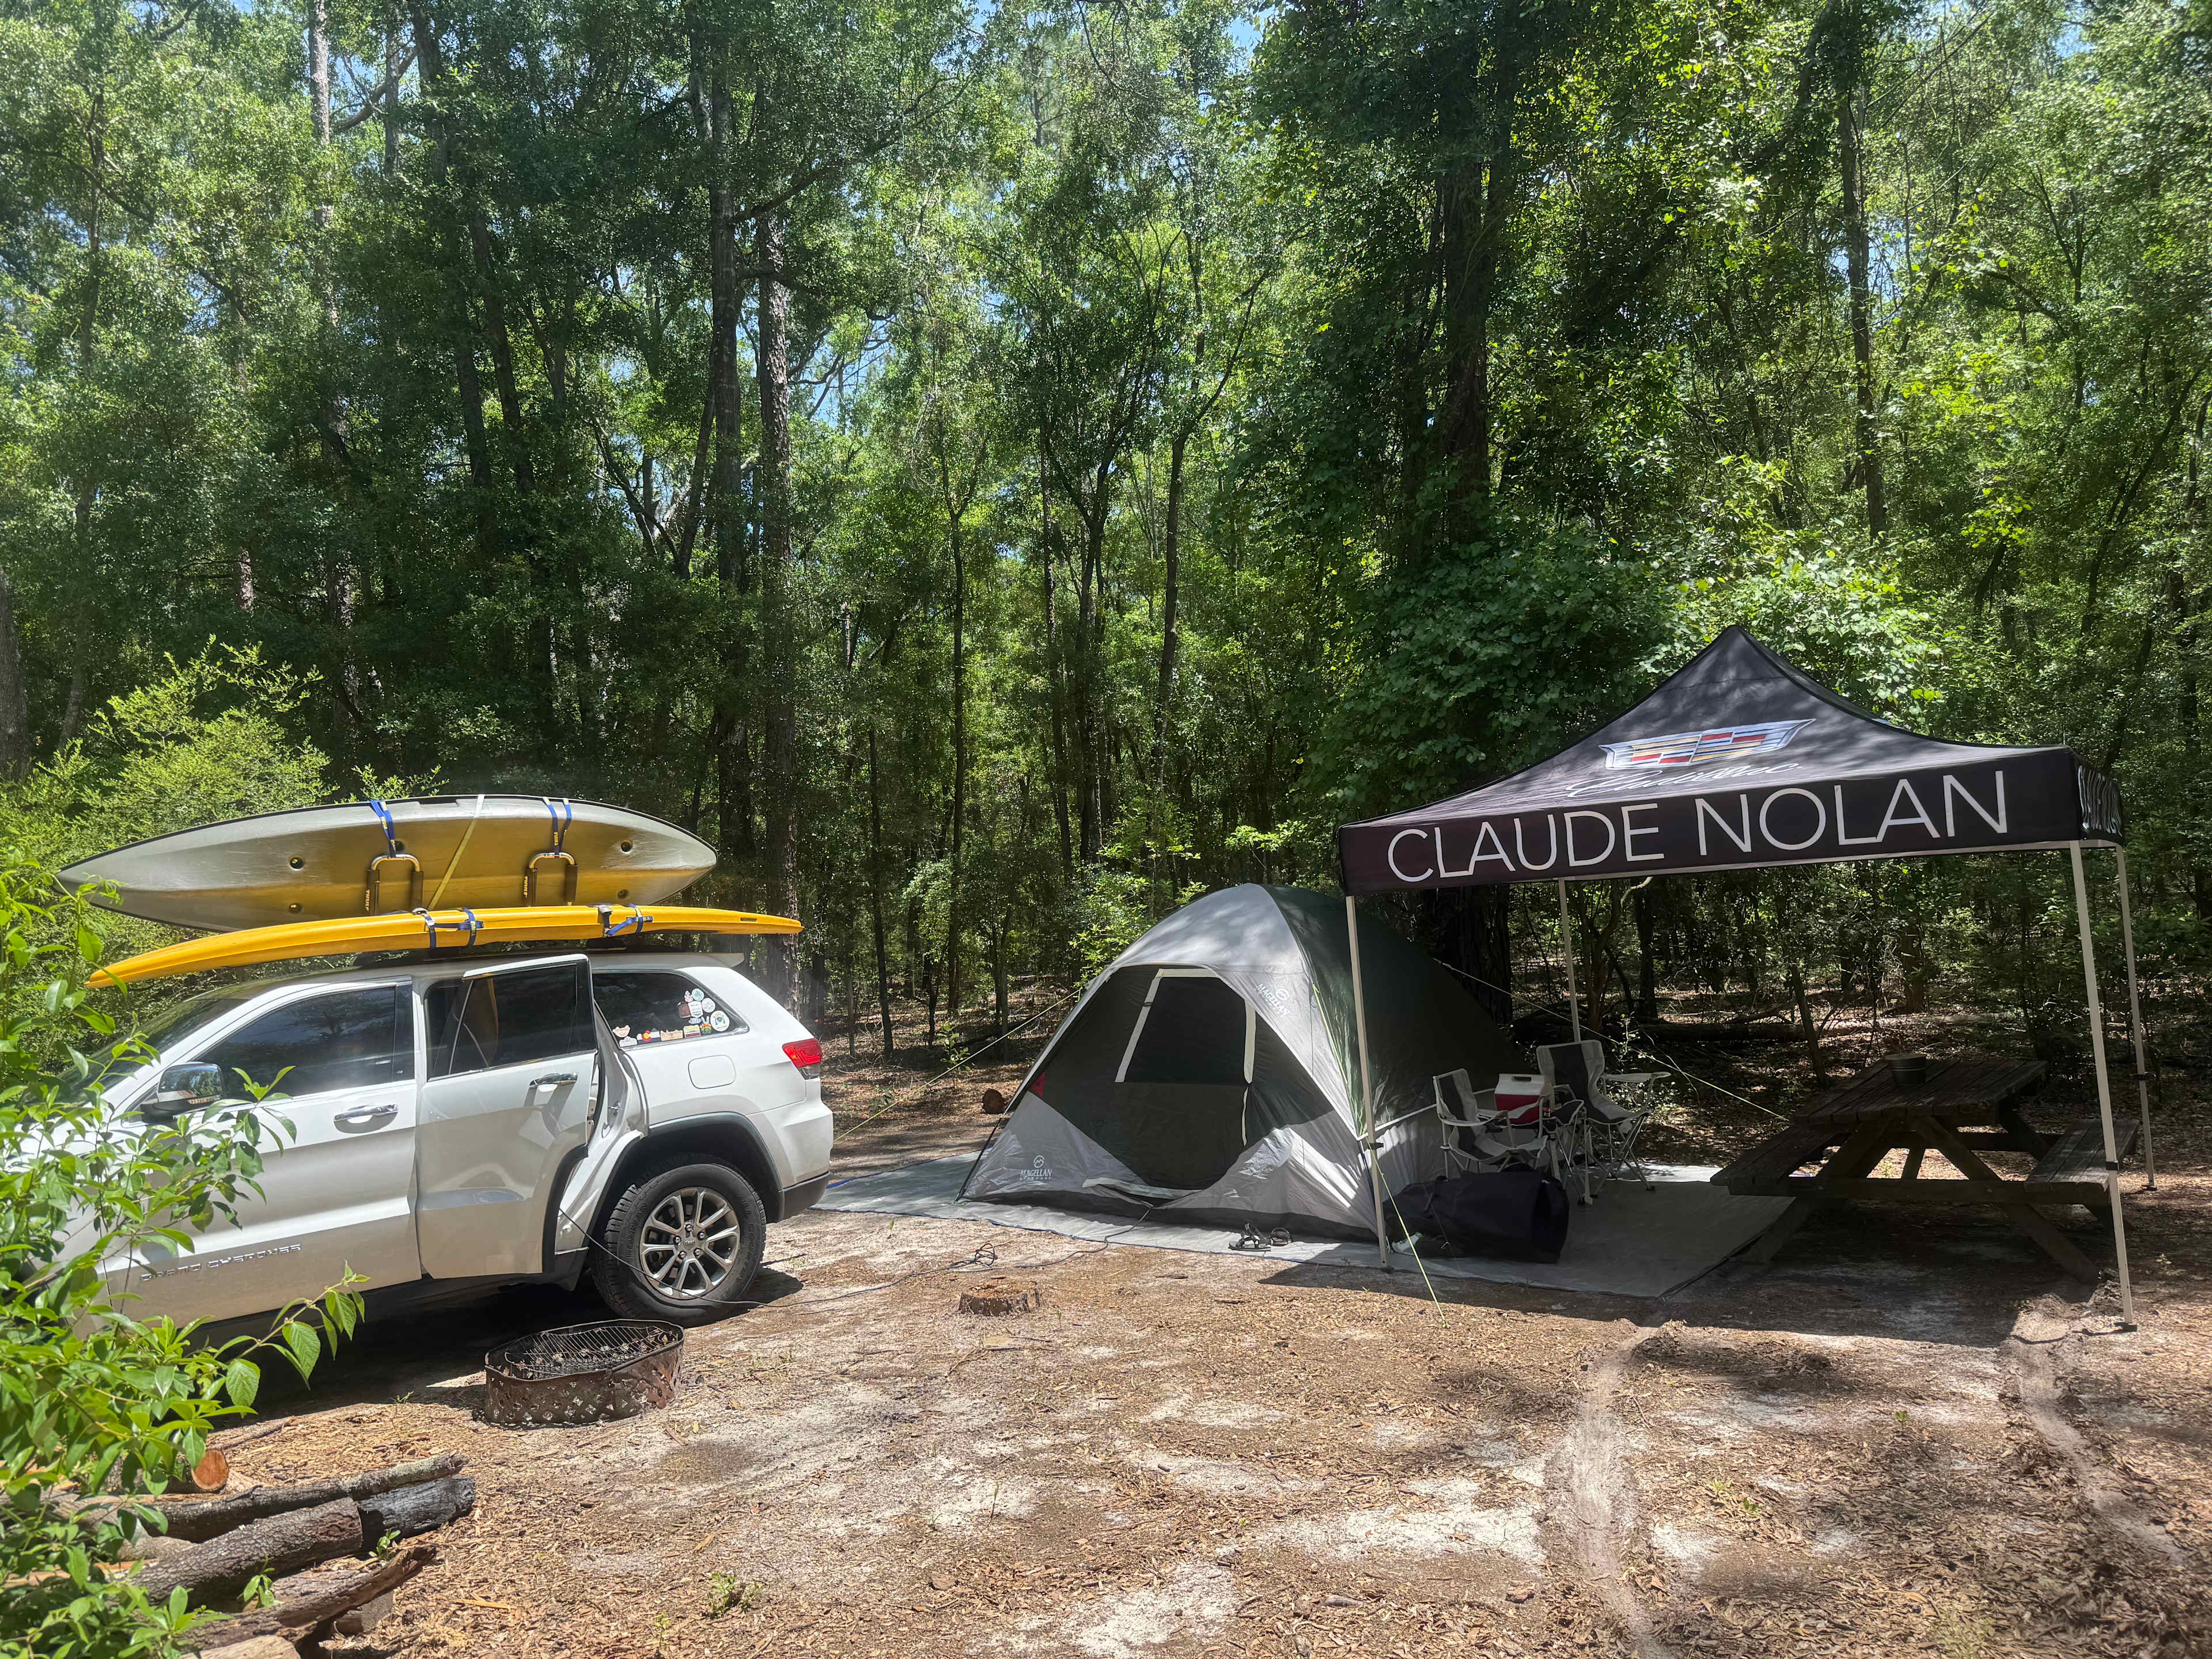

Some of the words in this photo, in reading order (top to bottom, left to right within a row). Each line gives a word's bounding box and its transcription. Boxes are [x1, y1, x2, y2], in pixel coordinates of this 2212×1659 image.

[1566, 763, 1799, 797] Cadillac
[1388, 803, 1665, 882] CLAUDE
[1695, 771, 2008, 855] NOLAN
[1019, 1169, 1052, 1180] MAGELLAN
